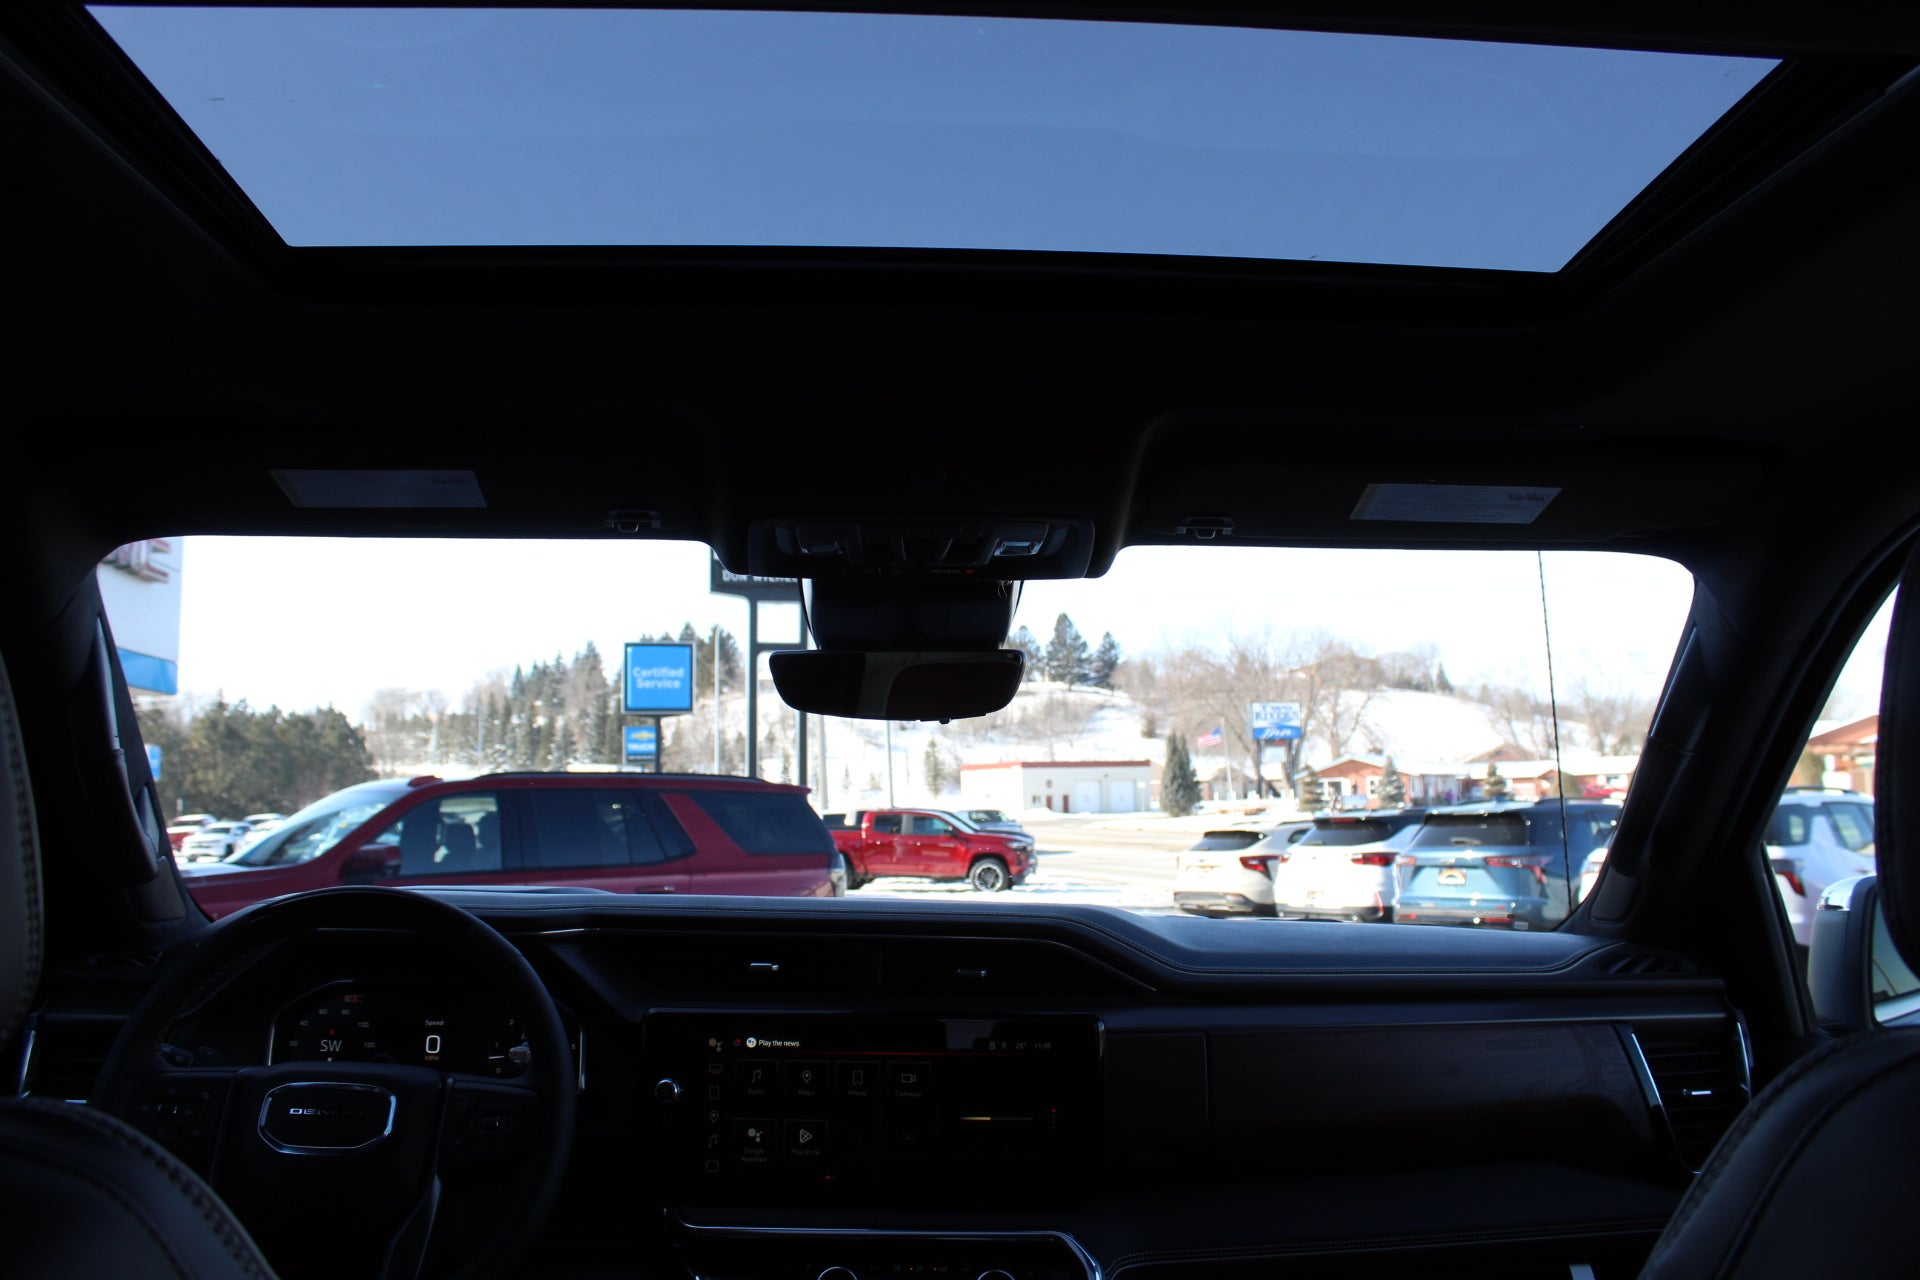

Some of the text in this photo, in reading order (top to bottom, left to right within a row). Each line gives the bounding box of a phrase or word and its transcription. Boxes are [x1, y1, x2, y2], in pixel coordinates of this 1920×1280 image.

[632, 665, 685, 678] Certified
[636, 677, 681, 689] Service
[425, 1018, 445, 1027] Speed
[320, 1039, 342, 1052] SW
[425, 1034, 440, 1054] 0
[758, 1039, 772, 1048] Play
